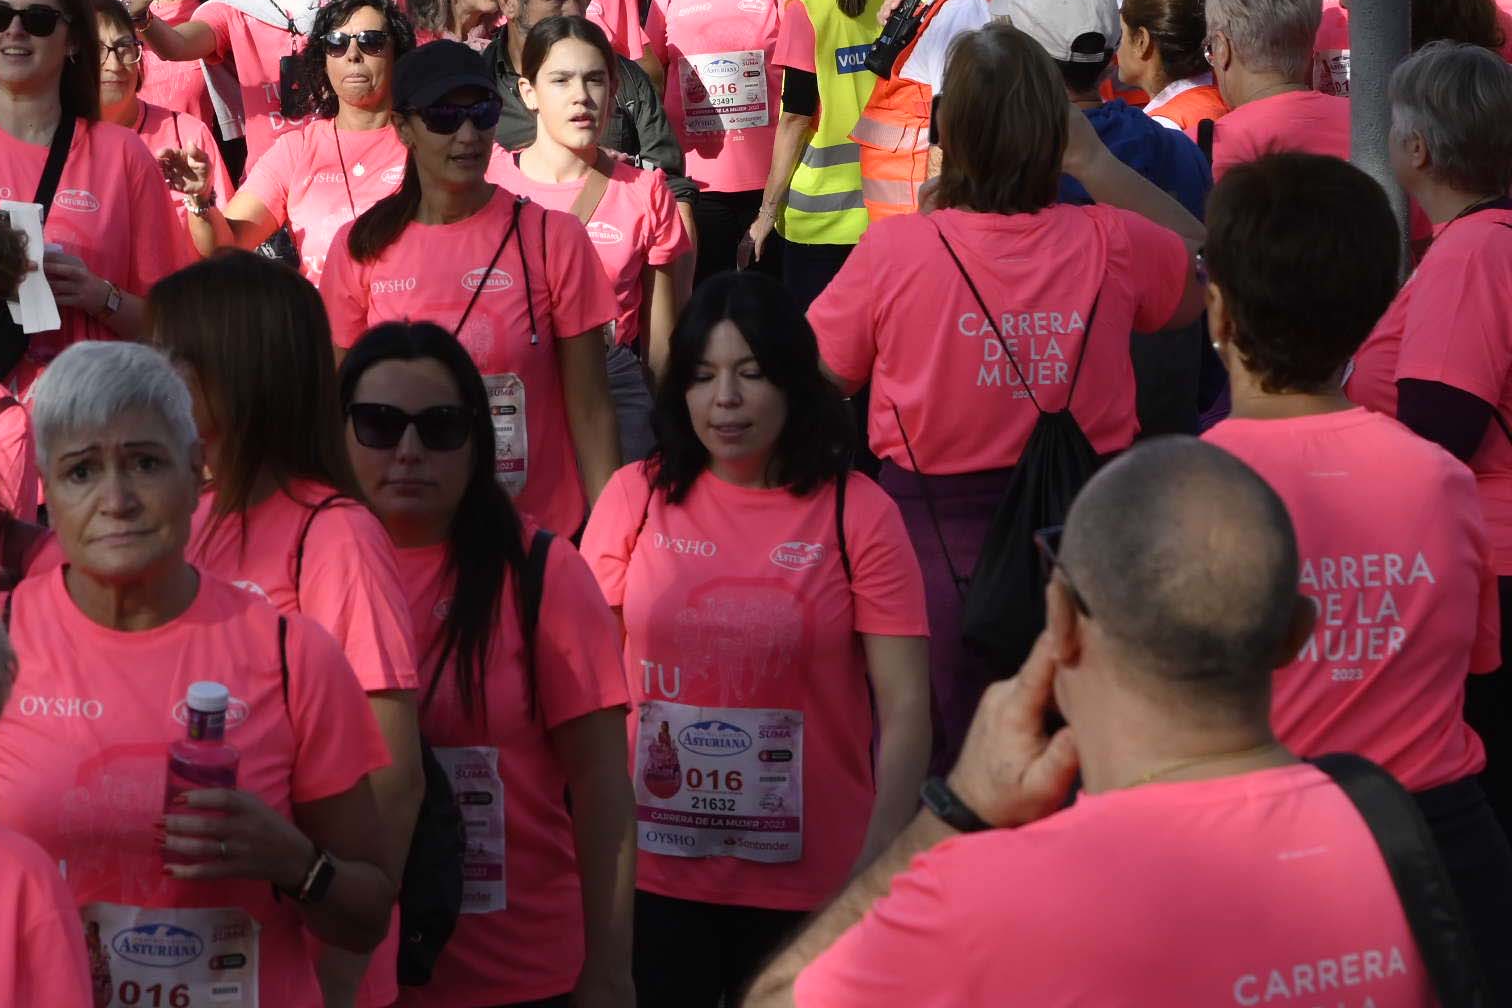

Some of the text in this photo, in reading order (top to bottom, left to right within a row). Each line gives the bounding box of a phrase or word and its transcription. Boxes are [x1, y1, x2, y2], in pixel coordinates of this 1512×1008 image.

[838, 52, 866, 67] VOL
[709, 83, 737, 95] 016
[1335, 81, 1349, 92] 01
[371, 277, 416, 295] OYSHO
[958, 310, 1085, 336] CARRERA
[984, 336, 1064, 362] DE LA
[976, 362, 1069, 387] MUJER
[1299, 552, 1436, 591] ARRERA
[1357, 590, 1400, 624] LA
[641, 659, 681, 699] TU
[20, 695, 104, 721] OYSHO
[684, 733, 747, 749] ASTURIANA
[759, 728, 792, 739] SUMA
[686, 768, 744, 791] 016
[691, 796, 736, 812] 21632
[651, 811, 693, 825] CARRERA
[696, 817, 709, 826] DE
[711, 818, 724, 827] LA
[726, 819, 760, 828] MUJER
[646, 830, 791, 850] OYSHO Santander
[119, 935, 197, 958] ASTURIANA
[1233, 946, 1407, 1006] CARRERA
[119, 980, 191, 1008] 016
